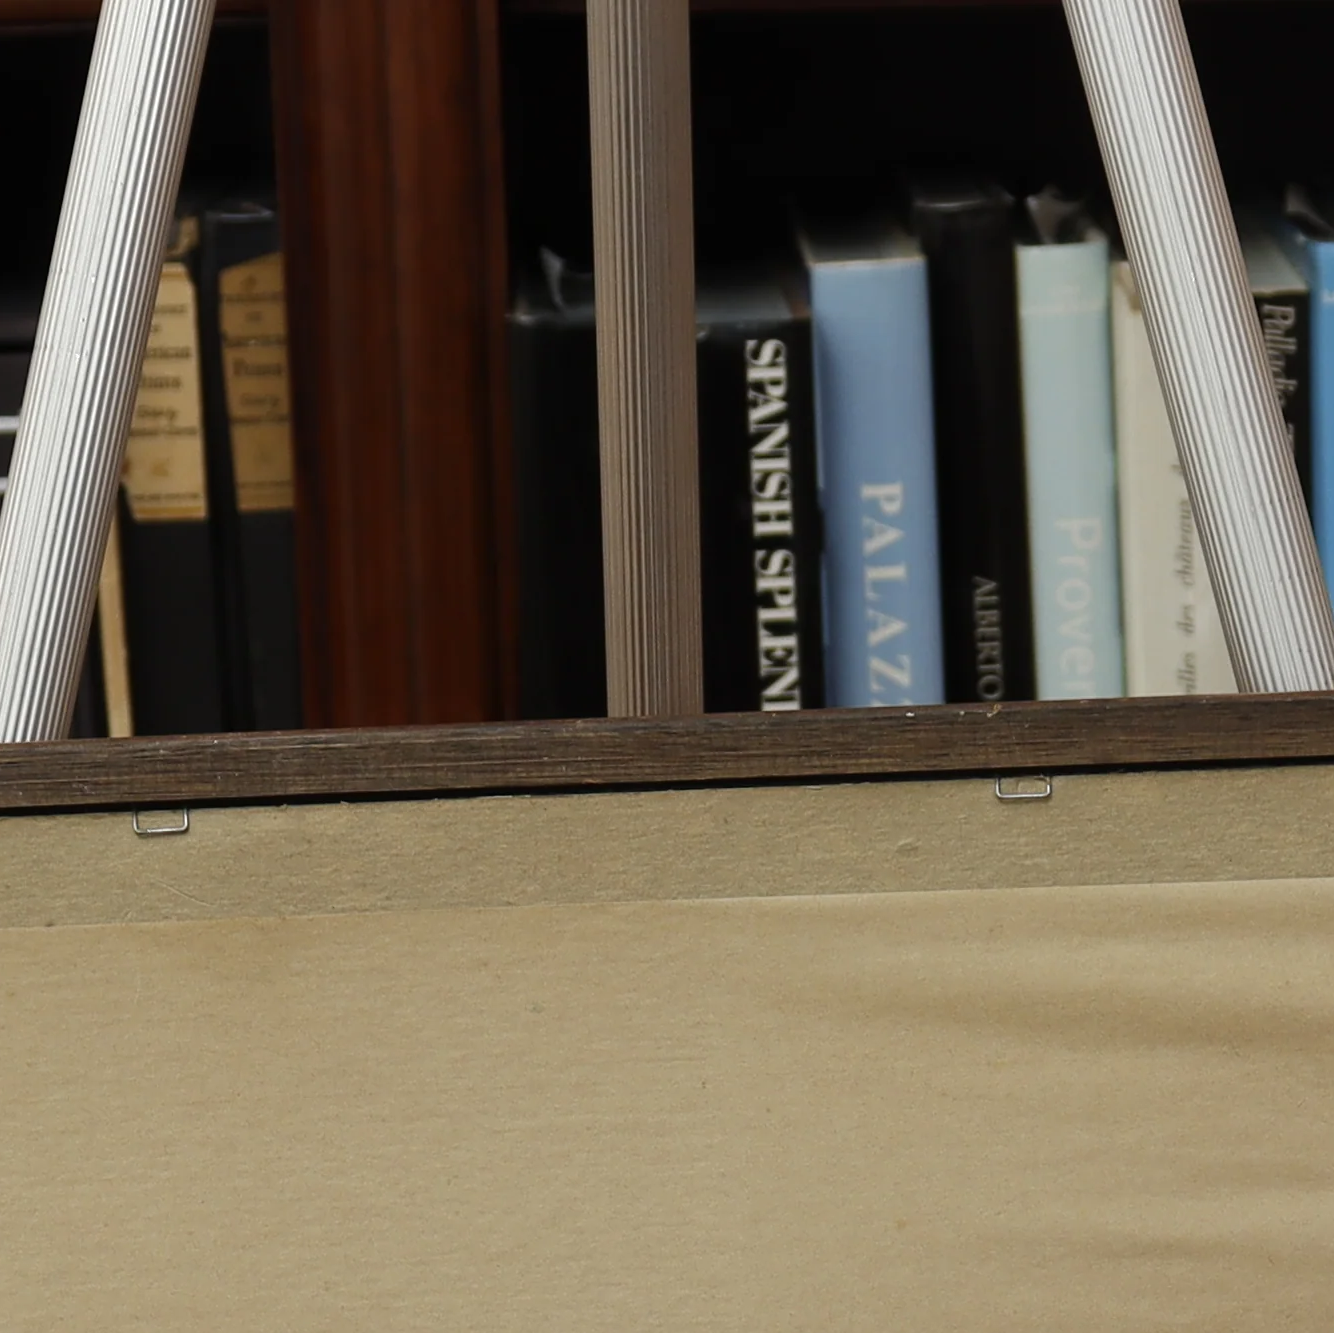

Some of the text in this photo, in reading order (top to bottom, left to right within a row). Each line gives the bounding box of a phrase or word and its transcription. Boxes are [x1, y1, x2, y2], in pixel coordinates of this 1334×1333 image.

[745, 338, 794, 537] SPANISH
[861, 481, 916, 706] PALAZ
[973, 575, 1005, 702] ALBERTO
